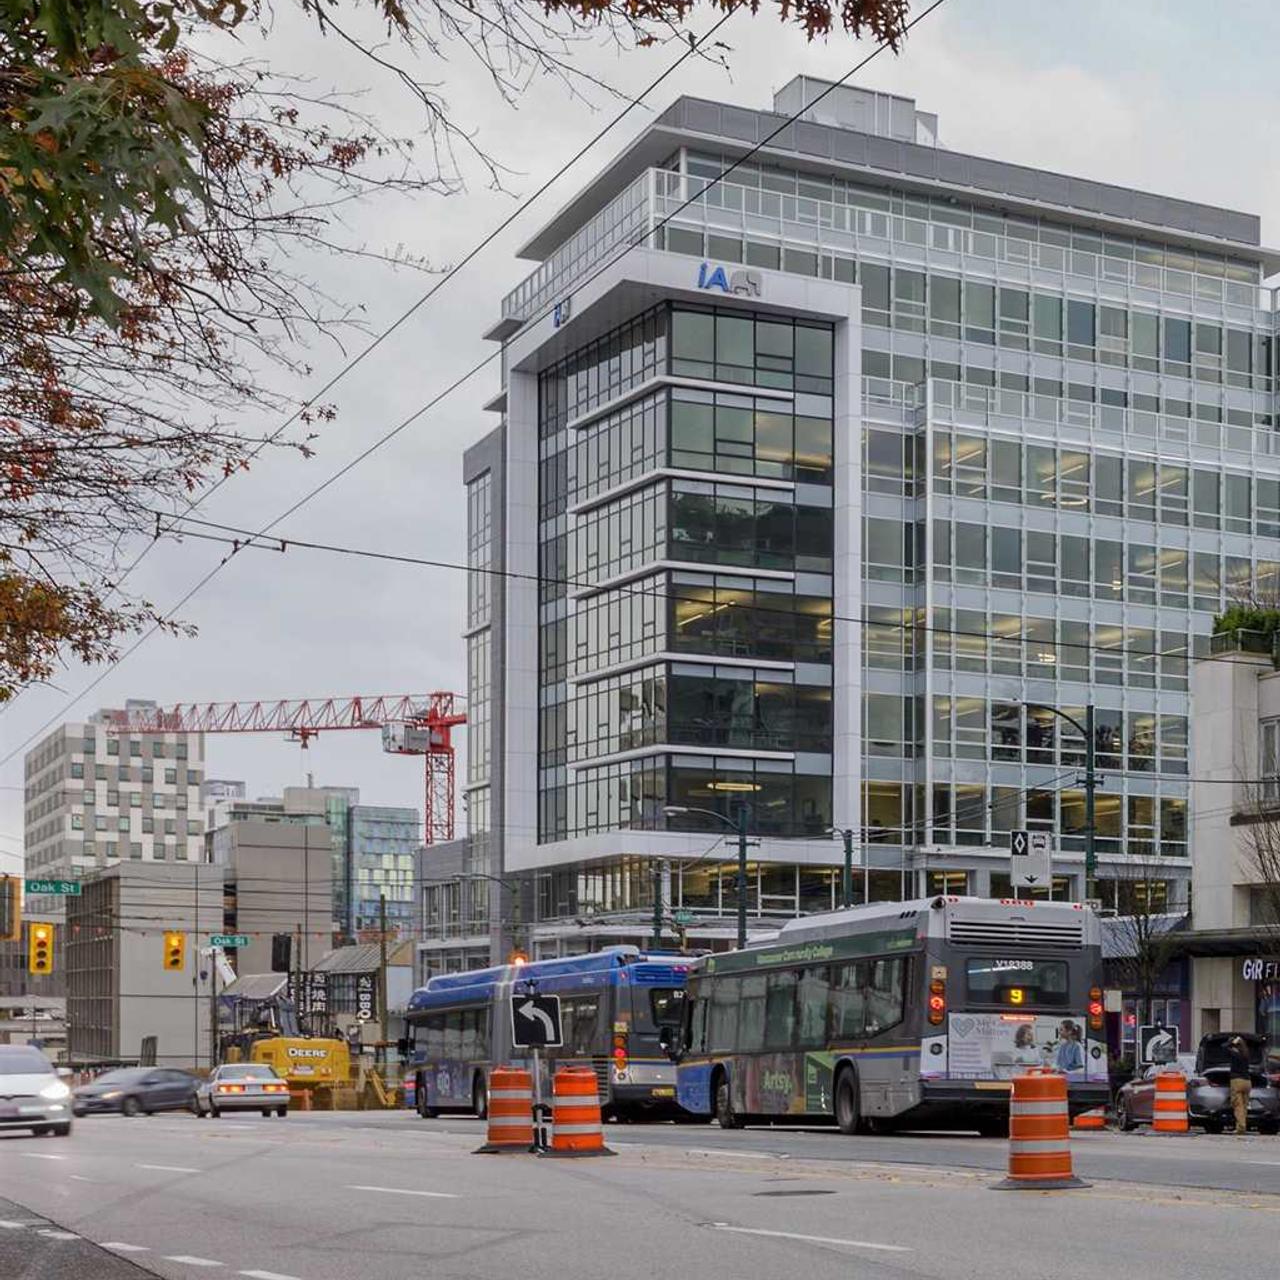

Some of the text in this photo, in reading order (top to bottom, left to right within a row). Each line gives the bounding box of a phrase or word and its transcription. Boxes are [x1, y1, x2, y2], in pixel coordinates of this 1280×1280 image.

[30, 882, 75, 893] Oak St
[214, 937, 232, 945] Oak
[1010, 989, 1023, 1003] 9
[356, 993, 371, 1019] BBQ
[288, 1047, 328, 1058] DEERE
